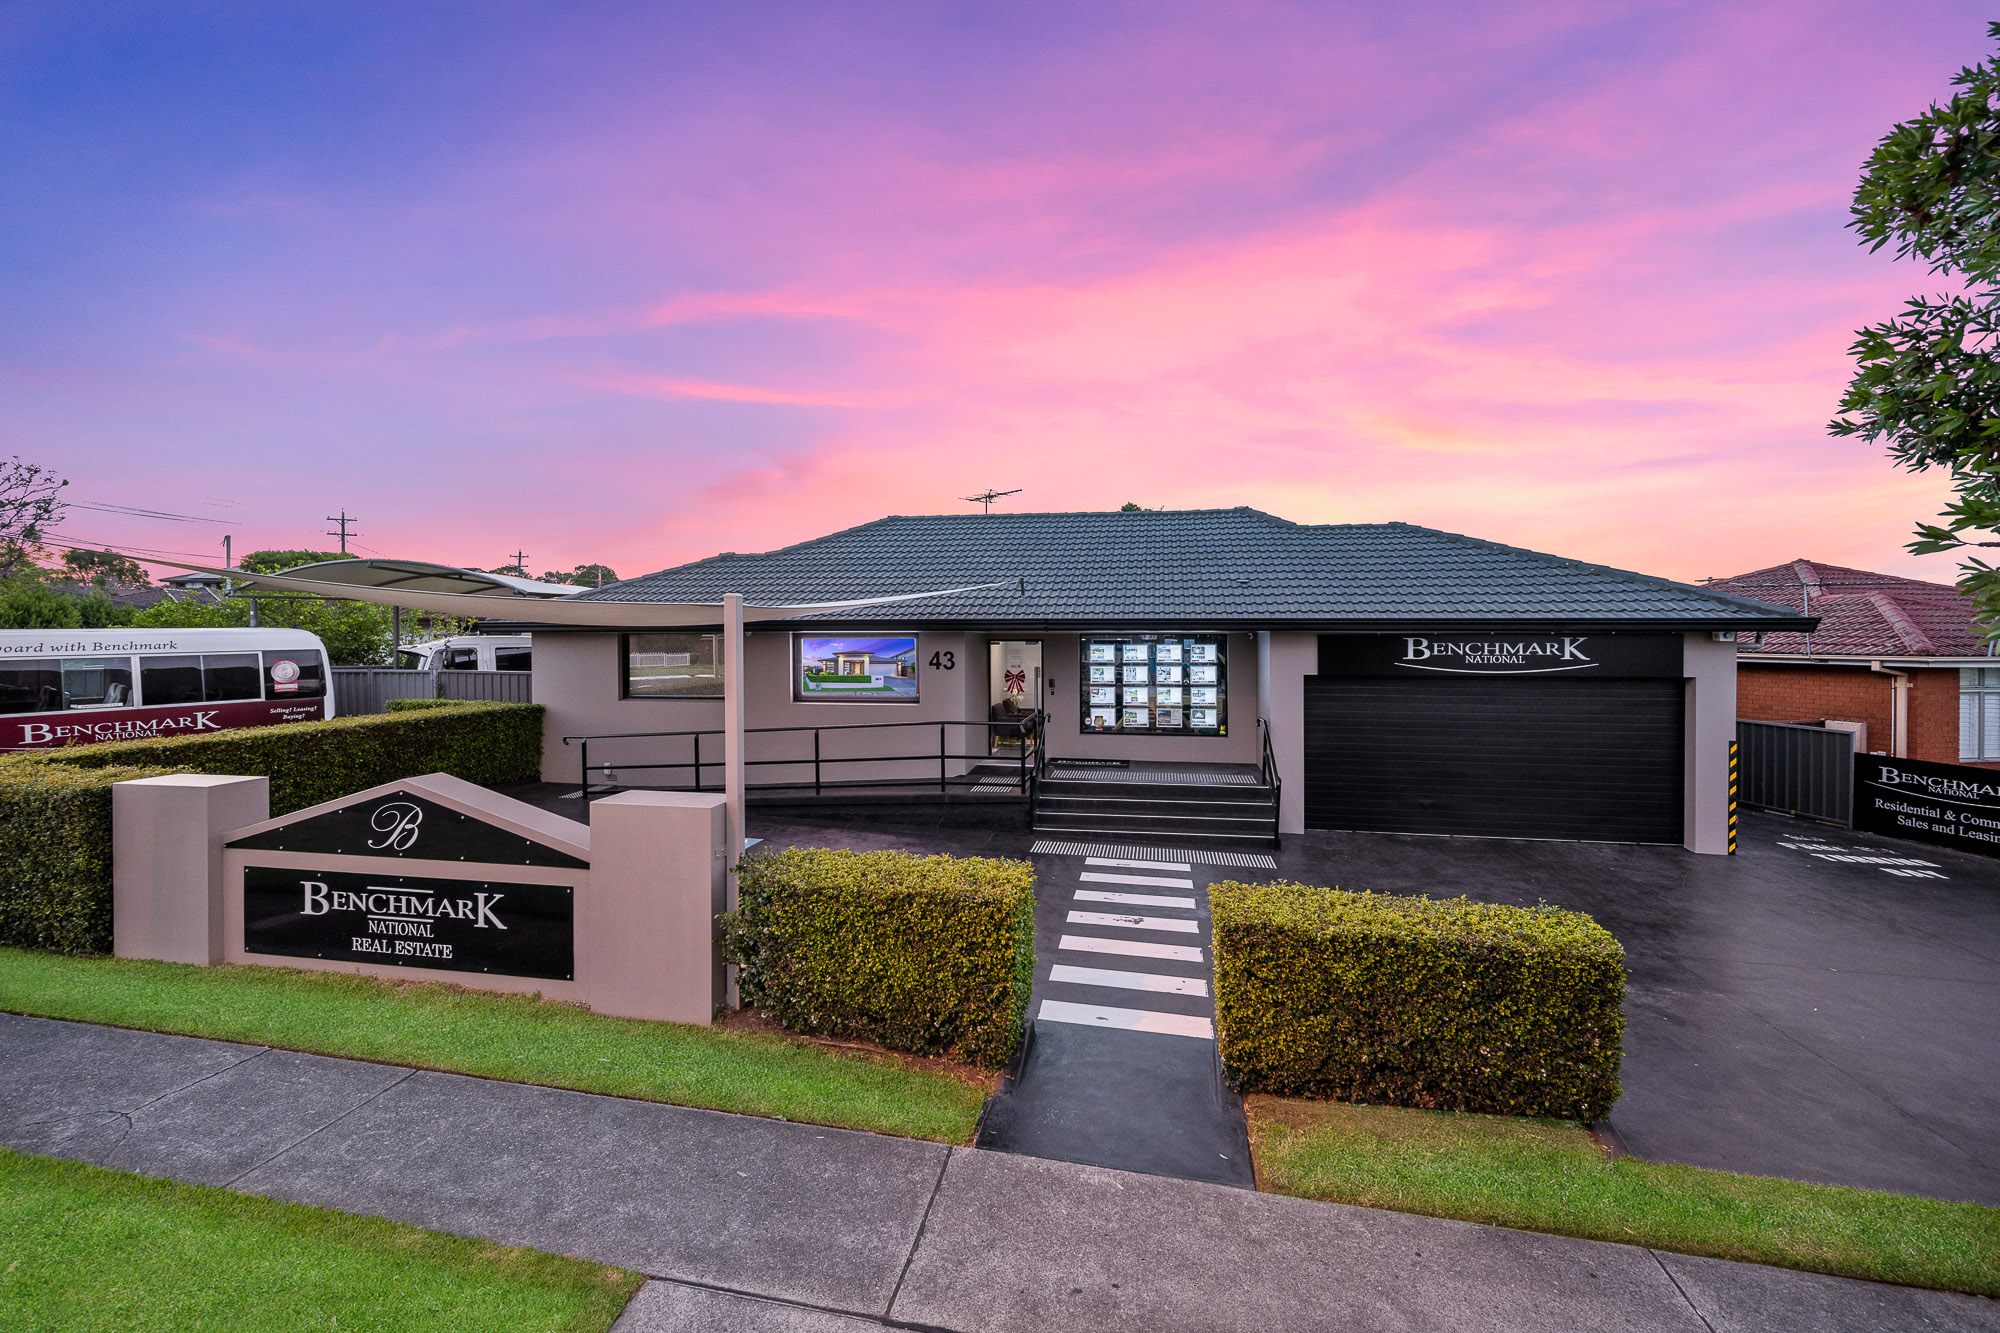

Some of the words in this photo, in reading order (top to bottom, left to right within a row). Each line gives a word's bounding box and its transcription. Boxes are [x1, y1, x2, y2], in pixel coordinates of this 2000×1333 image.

[0, 642, 44, 653] oard
[50, 642, 86, 652] with
[92, 640, 178, 651] Benchmark
[1402, 637, 1590, 661] BENCHMARK
[929, 651, 955, 671] 43
[1465, 655, 1525, 664] NATIONAL
[293, 705, 318, 713] Leasing?
[18, 710, 221, 745] BENCHMARK
[95, 729, 159, 741] NATIONAL
[1928, 786, 1980, 799] NATIONAL
[1874, 798, 1940, 818] Residential
[1944, 810, 1957, 821] &
[367, 802, 423, 851] B
[1897, 815, 1929, 830] Sales
[1932, 824, 1955, 835] and
[300, 880, 508, 930] BENCHMARK
[368, 920, 434, 938] NATIONAL
[351, 937, 392, 954] REAL
[394, 940, 453, 959] ESTATE
